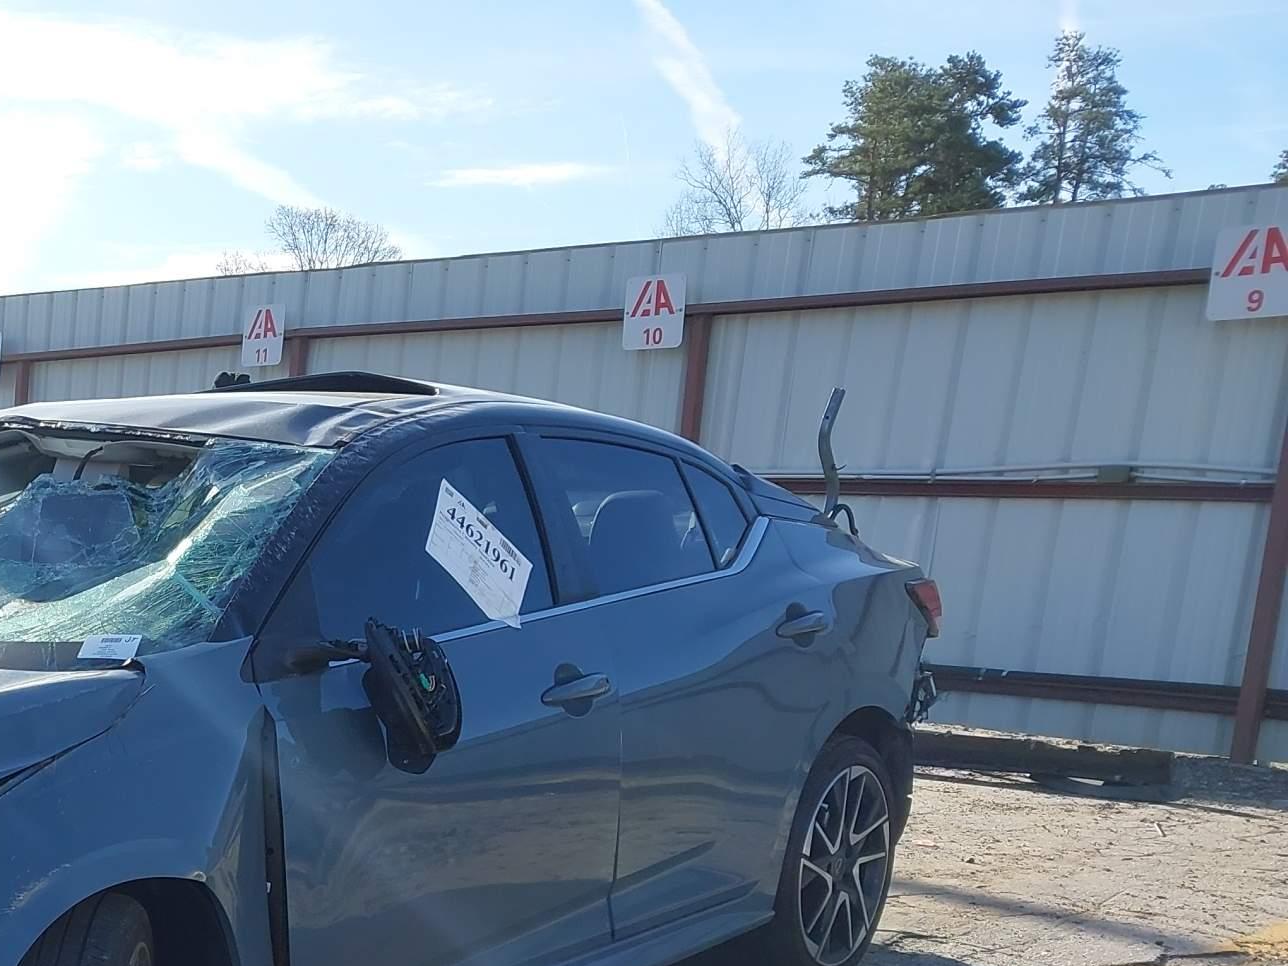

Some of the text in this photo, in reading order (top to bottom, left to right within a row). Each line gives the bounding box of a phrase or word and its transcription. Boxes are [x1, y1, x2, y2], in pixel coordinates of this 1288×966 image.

[1247, 289, 1264, 312] 9
[643, 327, 663, 345] 10
[255, 348, 268, 363] 11
[446, 507, 516, 580] 44621961
